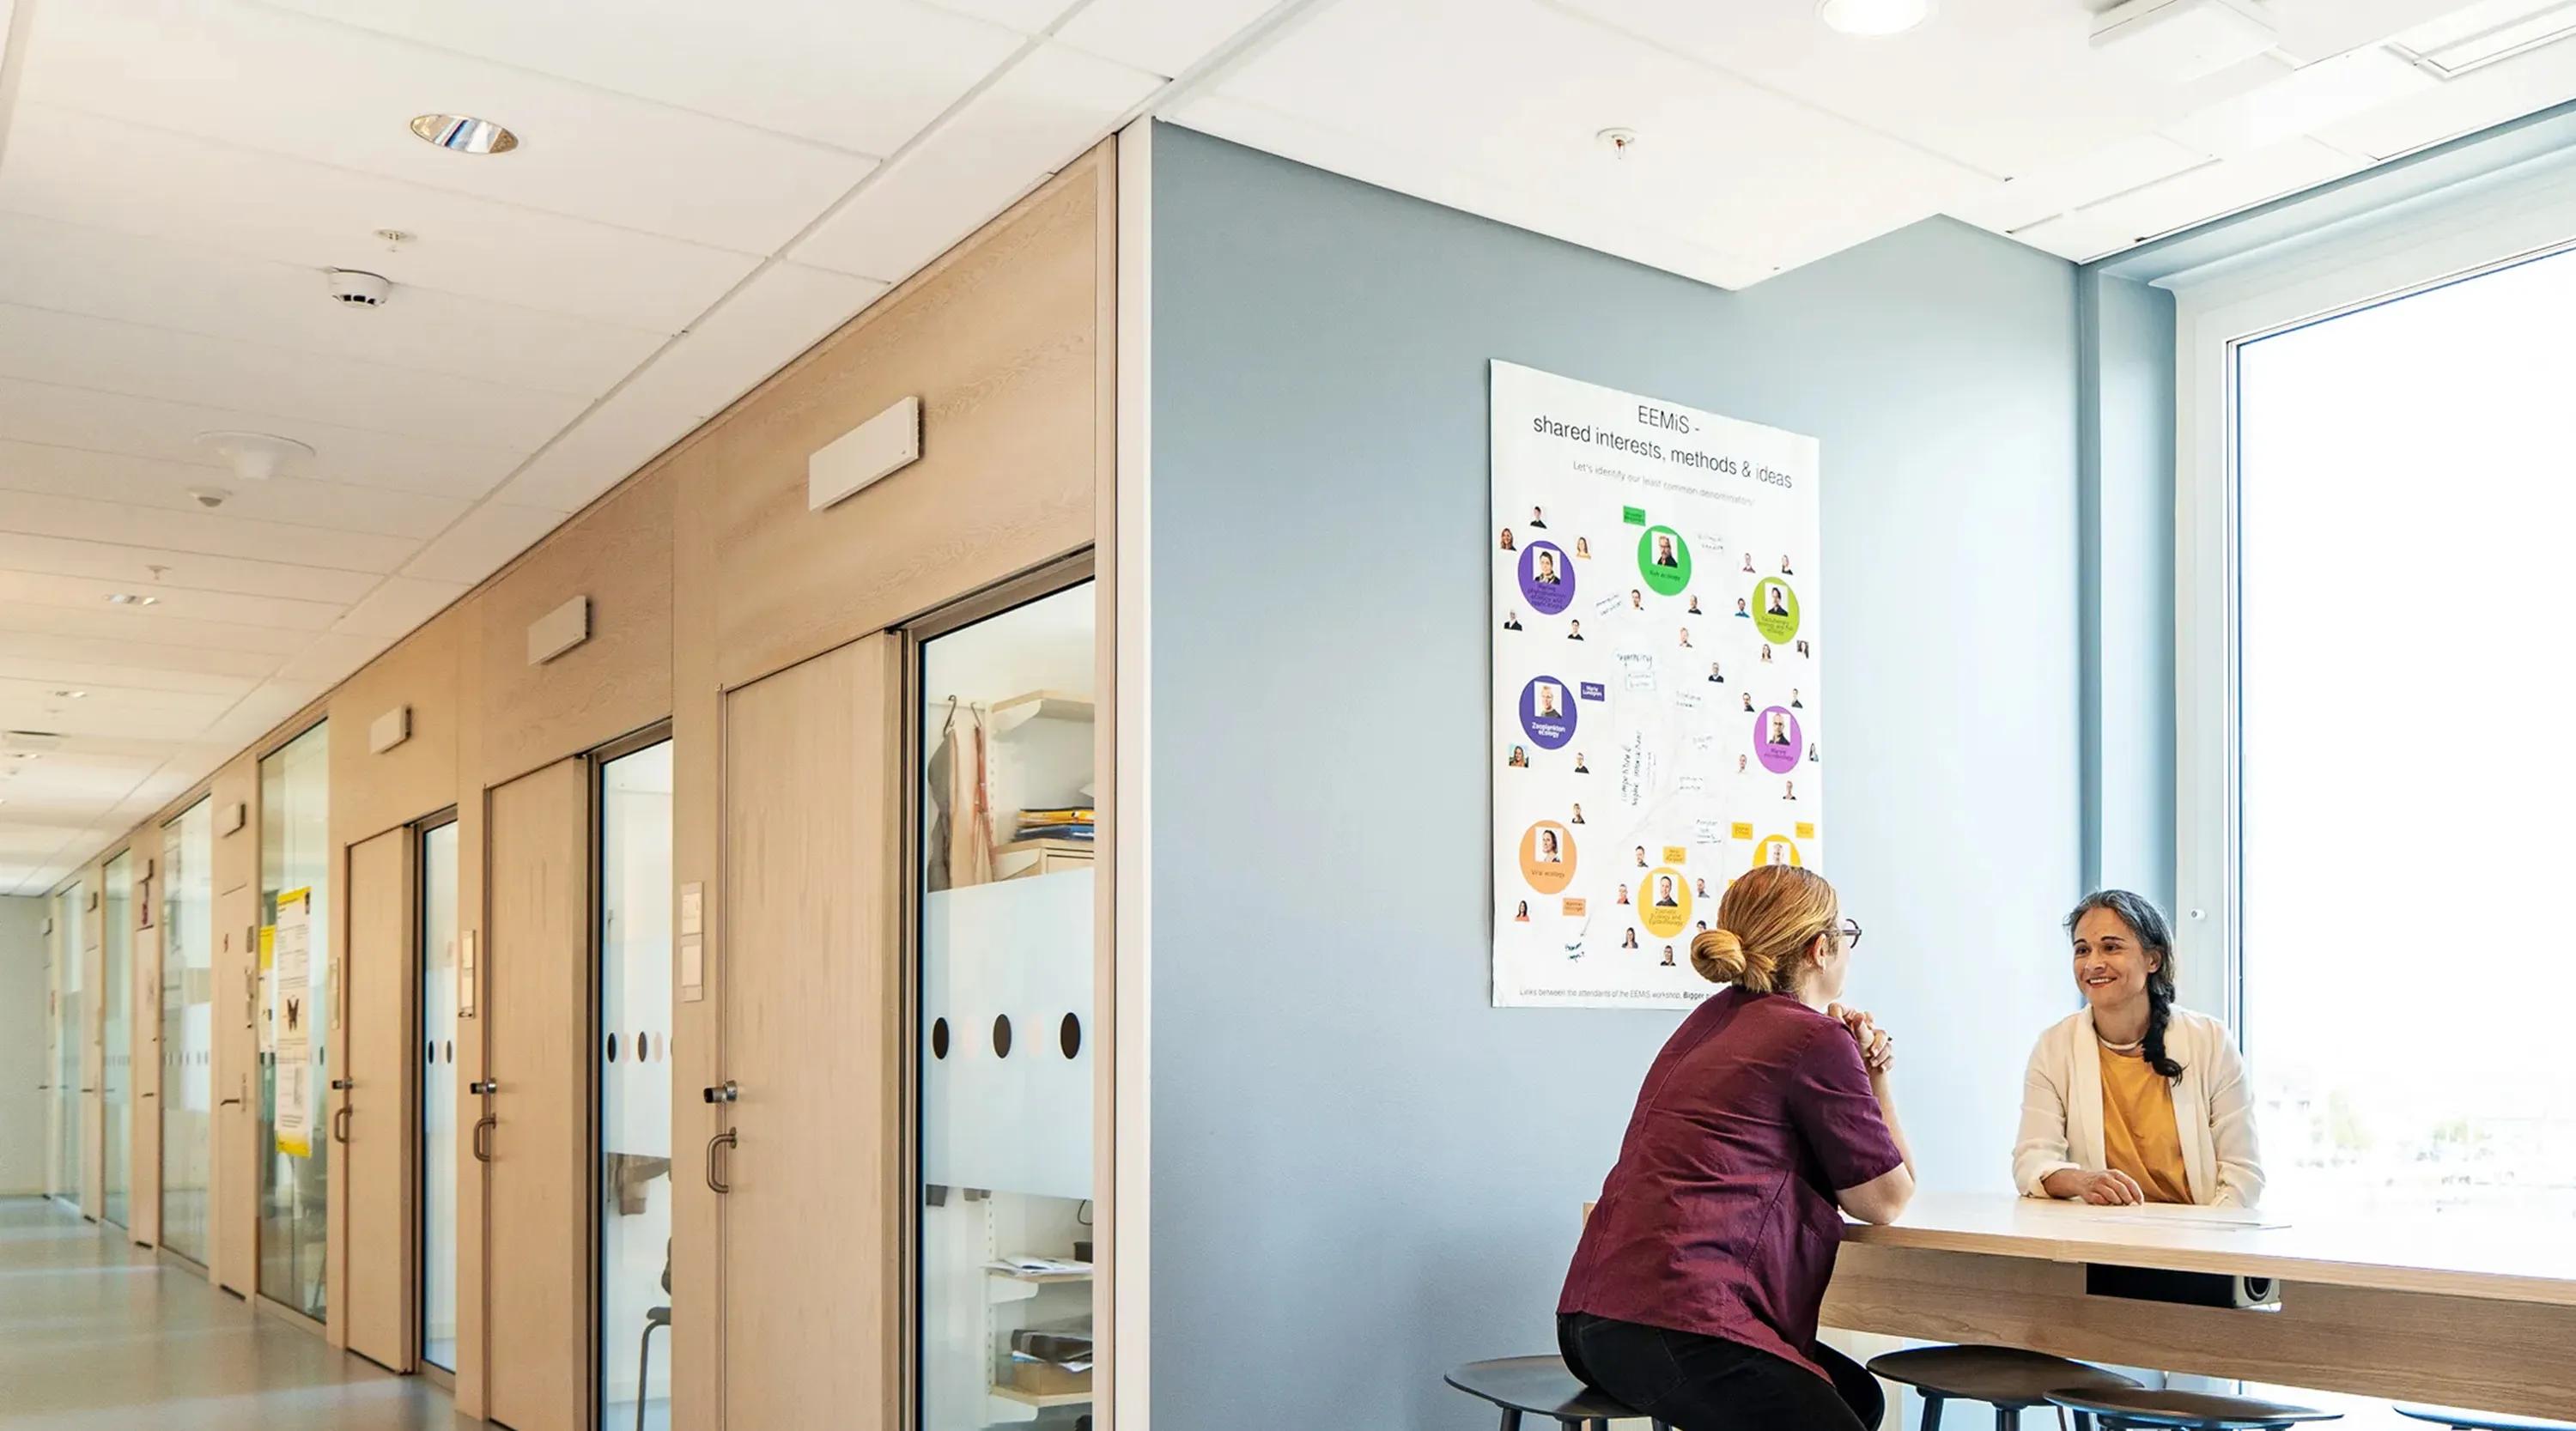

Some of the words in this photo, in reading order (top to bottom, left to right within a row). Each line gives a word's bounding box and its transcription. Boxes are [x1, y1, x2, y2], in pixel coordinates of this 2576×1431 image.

[1638, 404, 1690, 434] EEMiS
[1533, 415, 1590, 443] shared
[1595, 427, 1666, 463] interests,
[1671, 448, 1736, 475] methods
[1741, 460, 1751, 477] &
[1756, 463, 1793, 488] ideas
[1572, 460, 1593, 473] Let's
[1683, 991, 1704, 1001] Bigger
